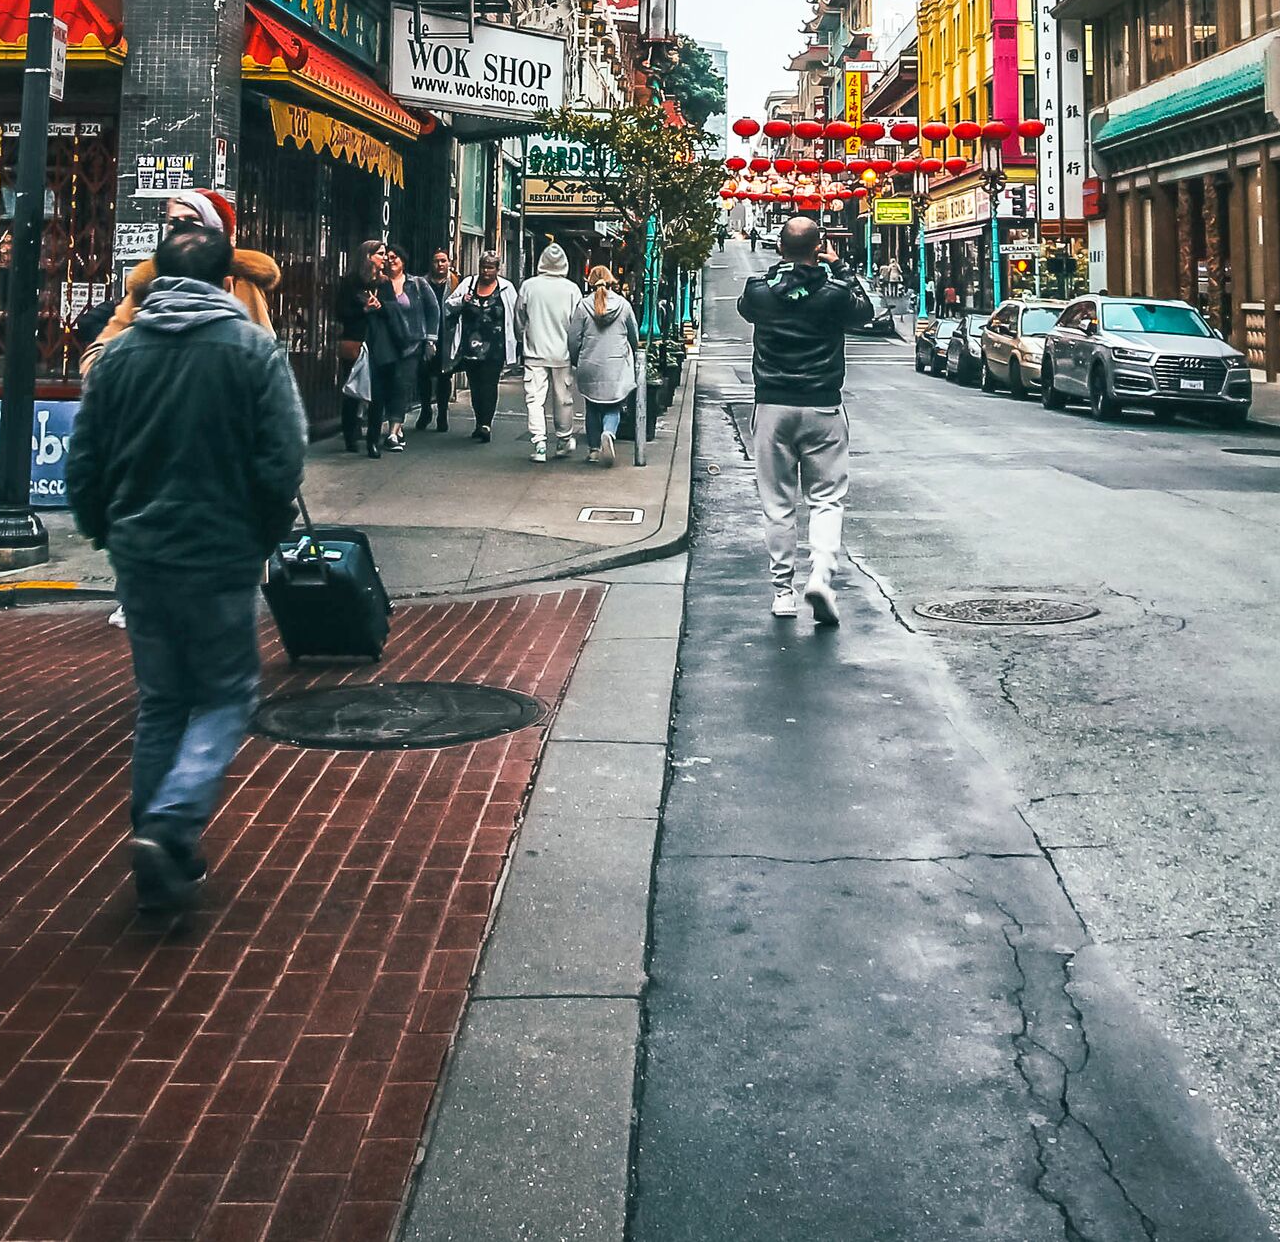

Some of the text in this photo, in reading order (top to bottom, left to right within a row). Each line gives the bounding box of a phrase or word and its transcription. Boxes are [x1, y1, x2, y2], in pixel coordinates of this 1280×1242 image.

[408, 16, 430, 37] te
[407, 39, 552, 90] WOK SHOP
[1044, 50, 1052, 80] of
[411, 75, 549, 107] www.wokshop.com
[1065, 48, 1081, 175] 國銀行
[1044, 98, 1055, 211] America
[529, 194, 575, 202] RESTAURANT
